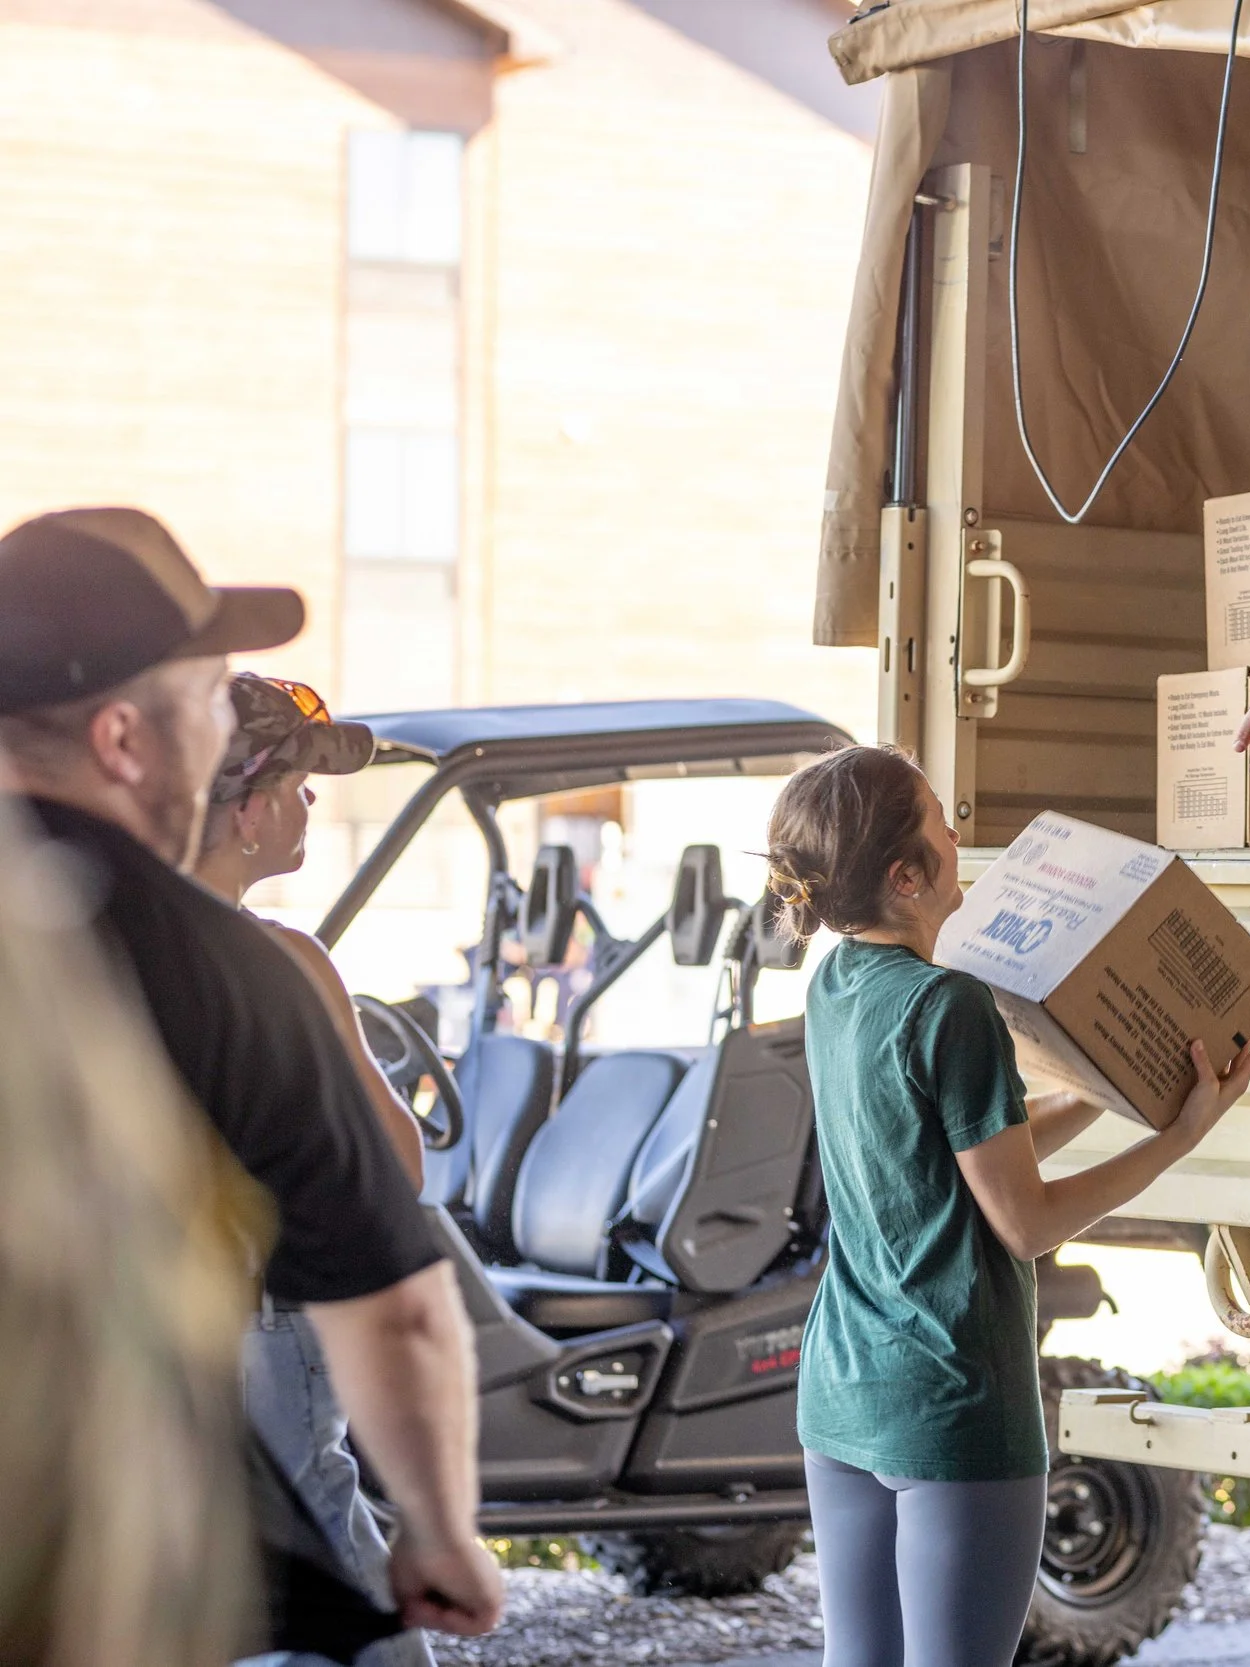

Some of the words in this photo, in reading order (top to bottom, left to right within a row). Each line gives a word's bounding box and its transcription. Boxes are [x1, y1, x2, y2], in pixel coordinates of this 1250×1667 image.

[1161, 1014, 1180, 1034] Ready
[1107, 1035, 1135, 1068] Emergency
[1153, 1036, 1173, 1060] Tasting
[1166, 1037, 1181, 1054] Meal
[1158, 1061, 1174, 1079] Meal
[1144, 1078, 1162, 1099] Ready
[1154, 1072, 1170, 1091] Long
